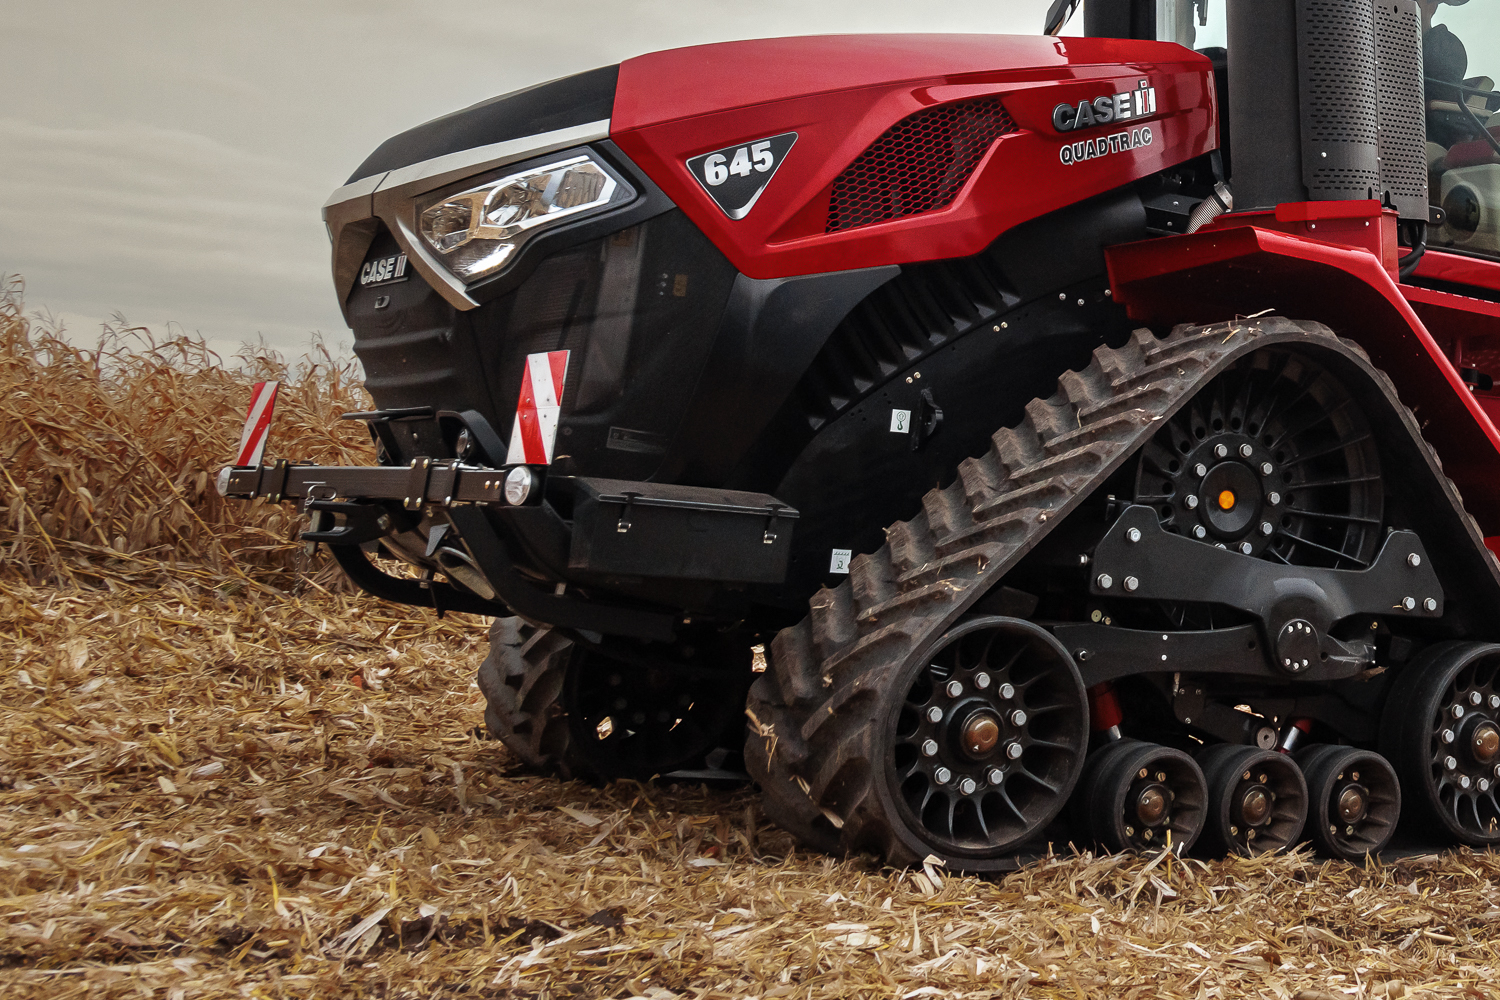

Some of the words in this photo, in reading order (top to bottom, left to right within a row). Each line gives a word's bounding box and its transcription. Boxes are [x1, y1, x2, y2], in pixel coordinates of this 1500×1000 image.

[1052, 92, 1131, 133] CASE
[704, 140, 774, 186] 645
[1060, 127, 1152, 165] QUADTRAC
[361, 257, 395, 284] CASE
